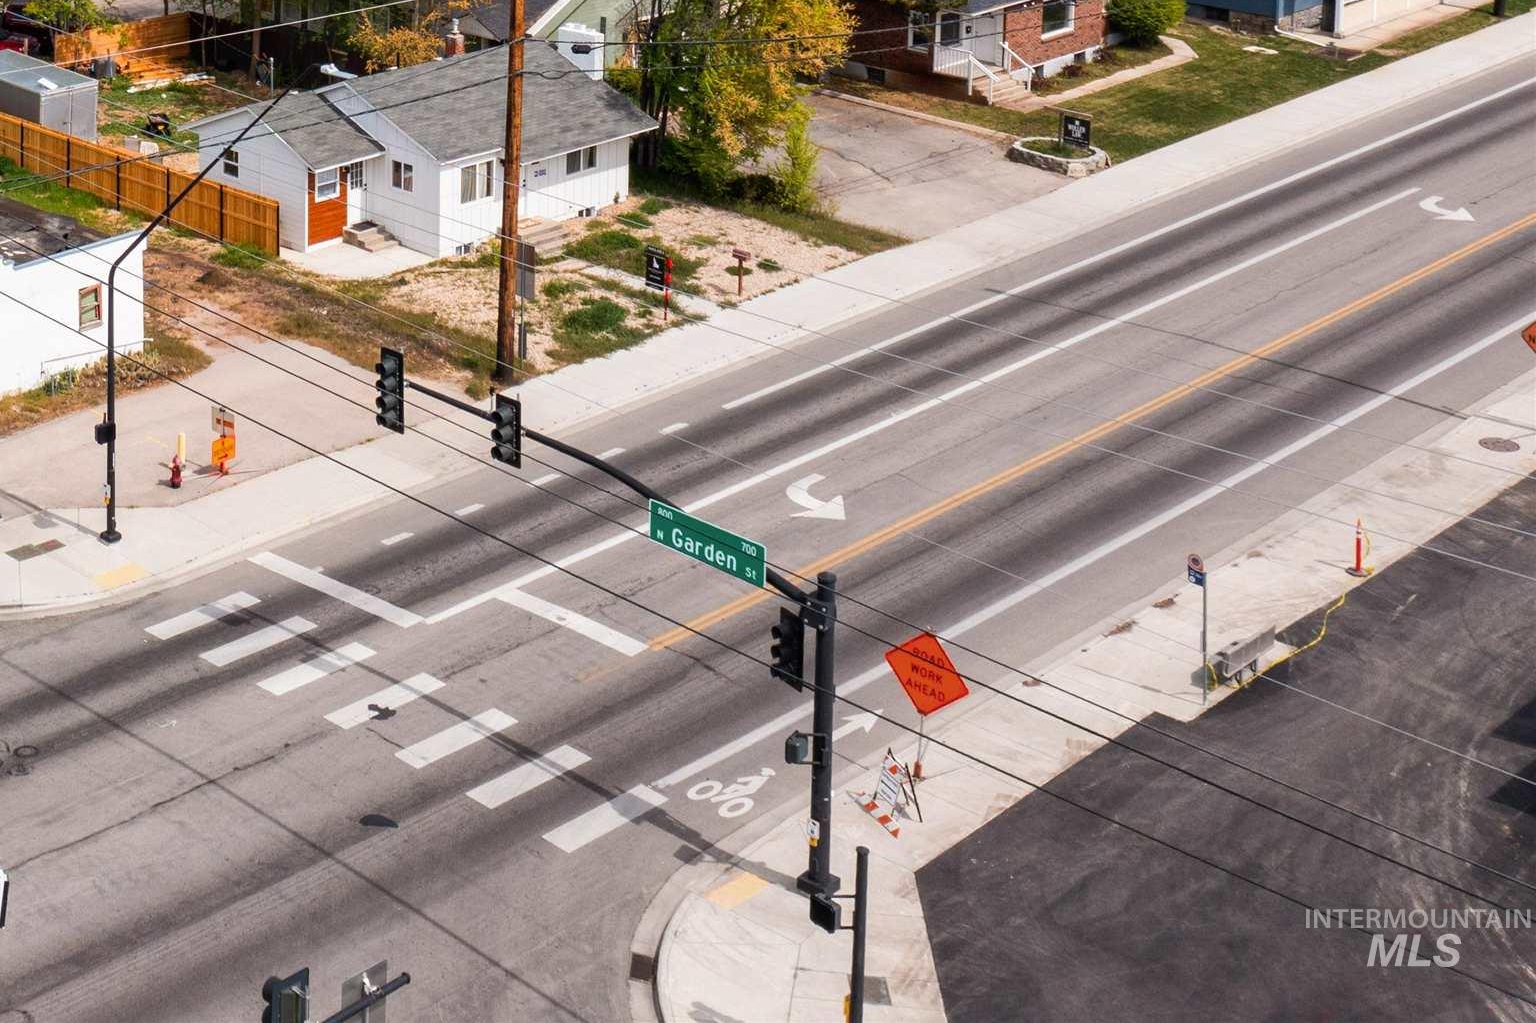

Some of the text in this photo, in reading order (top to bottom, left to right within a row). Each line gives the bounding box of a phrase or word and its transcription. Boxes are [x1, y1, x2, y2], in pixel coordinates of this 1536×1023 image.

[656, 528, 757, 580] N Garden St
[741, 542, 757, 557] 700
[911, 663, 943, 685] WORK
[905, 678, 946, 702] AHEAD
